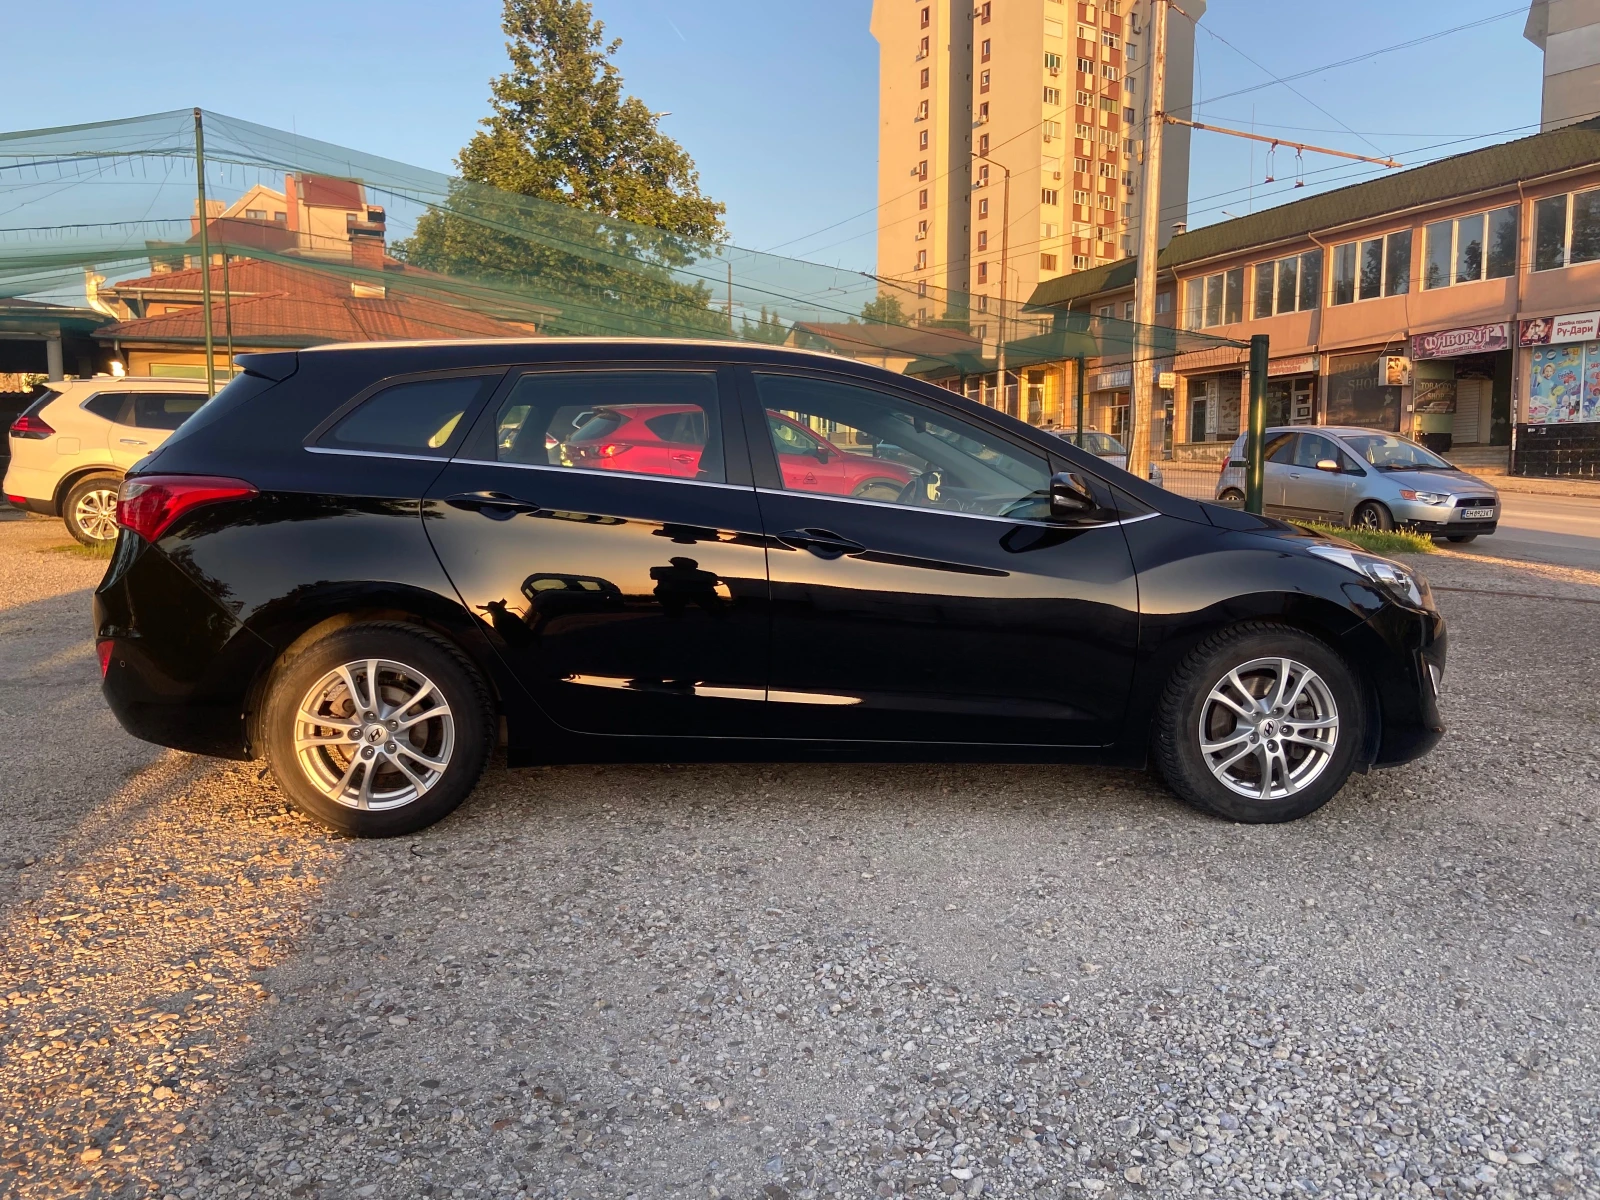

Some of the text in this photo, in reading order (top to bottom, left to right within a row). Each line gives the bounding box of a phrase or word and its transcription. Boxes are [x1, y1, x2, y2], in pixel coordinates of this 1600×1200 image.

[1557, 326, 1593, 337] Ру-Дари
[1420, 381, 1452, 390] TOBACCO
[1427, 392, 1445, 400] SHOP
